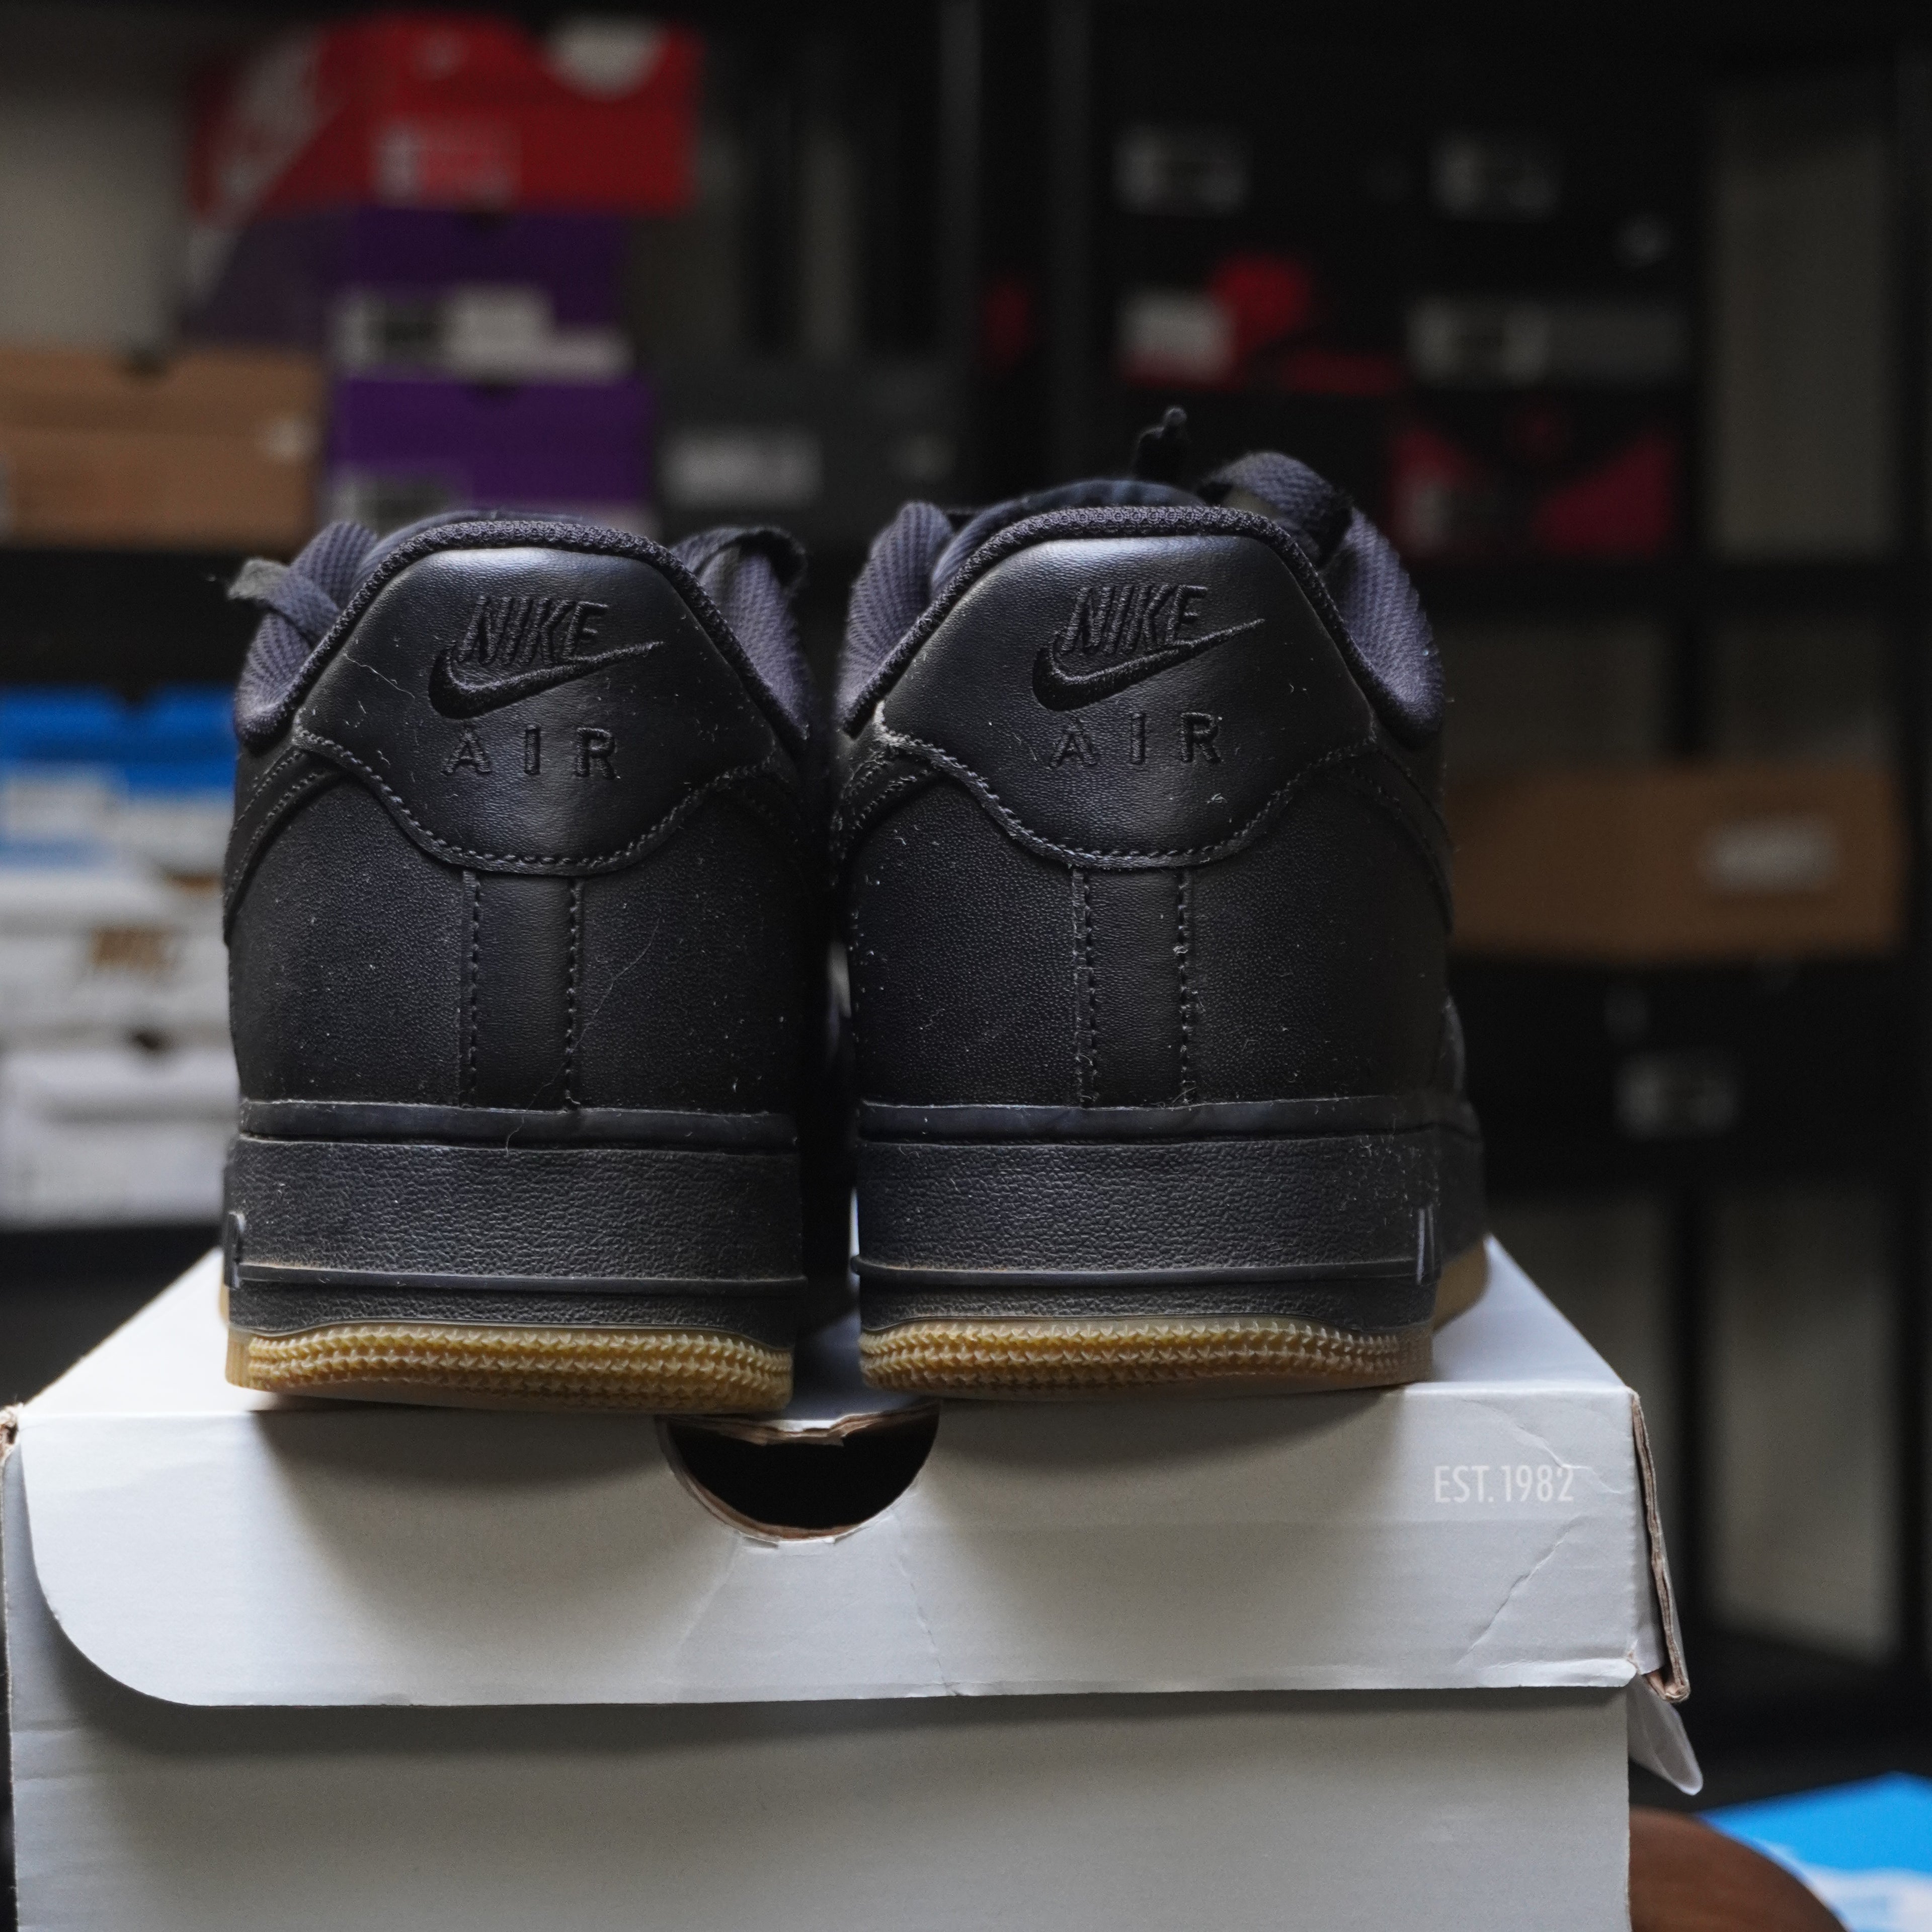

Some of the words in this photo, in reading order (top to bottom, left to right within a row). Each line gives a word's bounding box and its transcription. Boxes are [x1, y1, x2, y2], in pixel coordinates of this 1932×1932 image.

[456, 595, 608, 665] NIKE
[1059, 584, 1209, 655] NIKE
[441, 723, 619, 780] AIR
[1051, 712, 1222, 765] AIR
[1435, 1465, 1494, 1503] EST.
[1501, 1465, 1574, 1502] 1982
